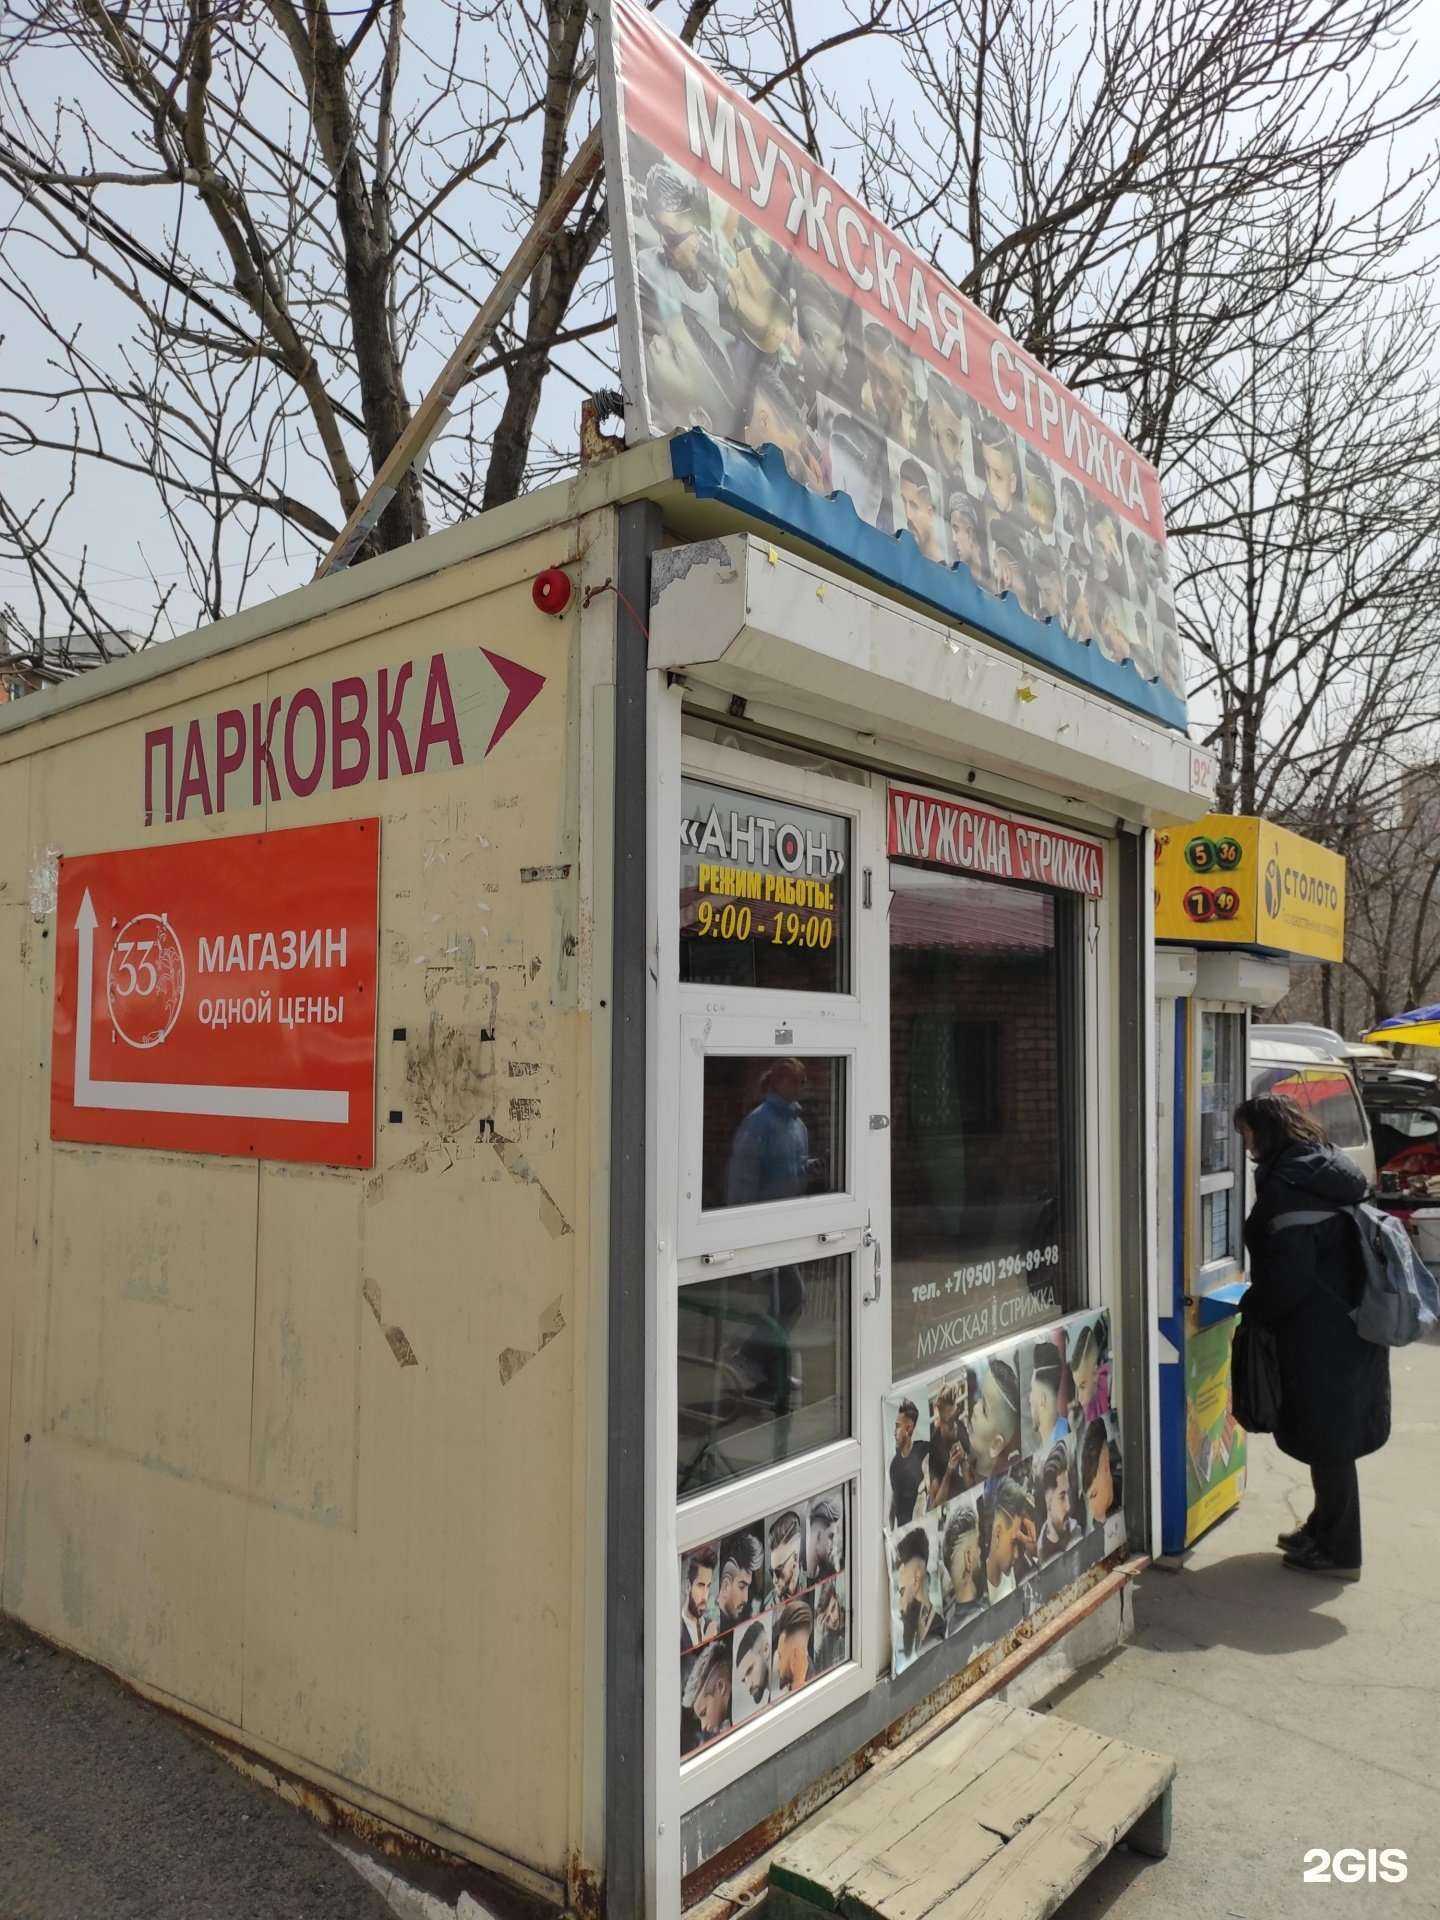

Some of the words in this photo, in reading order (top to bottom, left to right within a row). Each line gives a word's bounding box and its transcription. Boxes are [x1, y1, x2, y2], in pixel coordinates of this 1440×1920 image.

[685, 63, 968, 375] МУЖСКАЯ
[991, 340, 1150, 522] СТРИЖКА
[144, 653, 464, 827] ПАРКОВКА
[680, 803, 845, 877] «АНТОН»
[895, 795, 1012, 876] МУЖСКАЯ
[1015, 828, 1102, 897] СТРИЖКА
[1195, 845, 1207, 865] 5
[1220, 844, 1236, 861] 36
[698, 863, 761, 900] РЕЖИМ
[765, 875, 833, 910] РАБОТЫ:
[1192, 894, 1203, 914] 7
[1217, 893, 1233, 910] 49
[198, 928, 347, 973] МАГАЗИН
[698, 901, 751, 940] 9:00
[772, 911, 832, 949] 19:00
[116, 941, 157, 996] 33
[199, 990, 271, 1029] ОДНОЙ
[278, 996, 344, 1029] ЦЕНЫ
[912, 1282, 941, 1302] тел.
[945, 1260, 996, 1295] +7(950)
[998, 1244, 1058, 1280] 296-89-98
[917, 1309, 989, 1360] МУЖСКАЯ
[1000, 1286, 1056, 1327] СТРИЖКА
